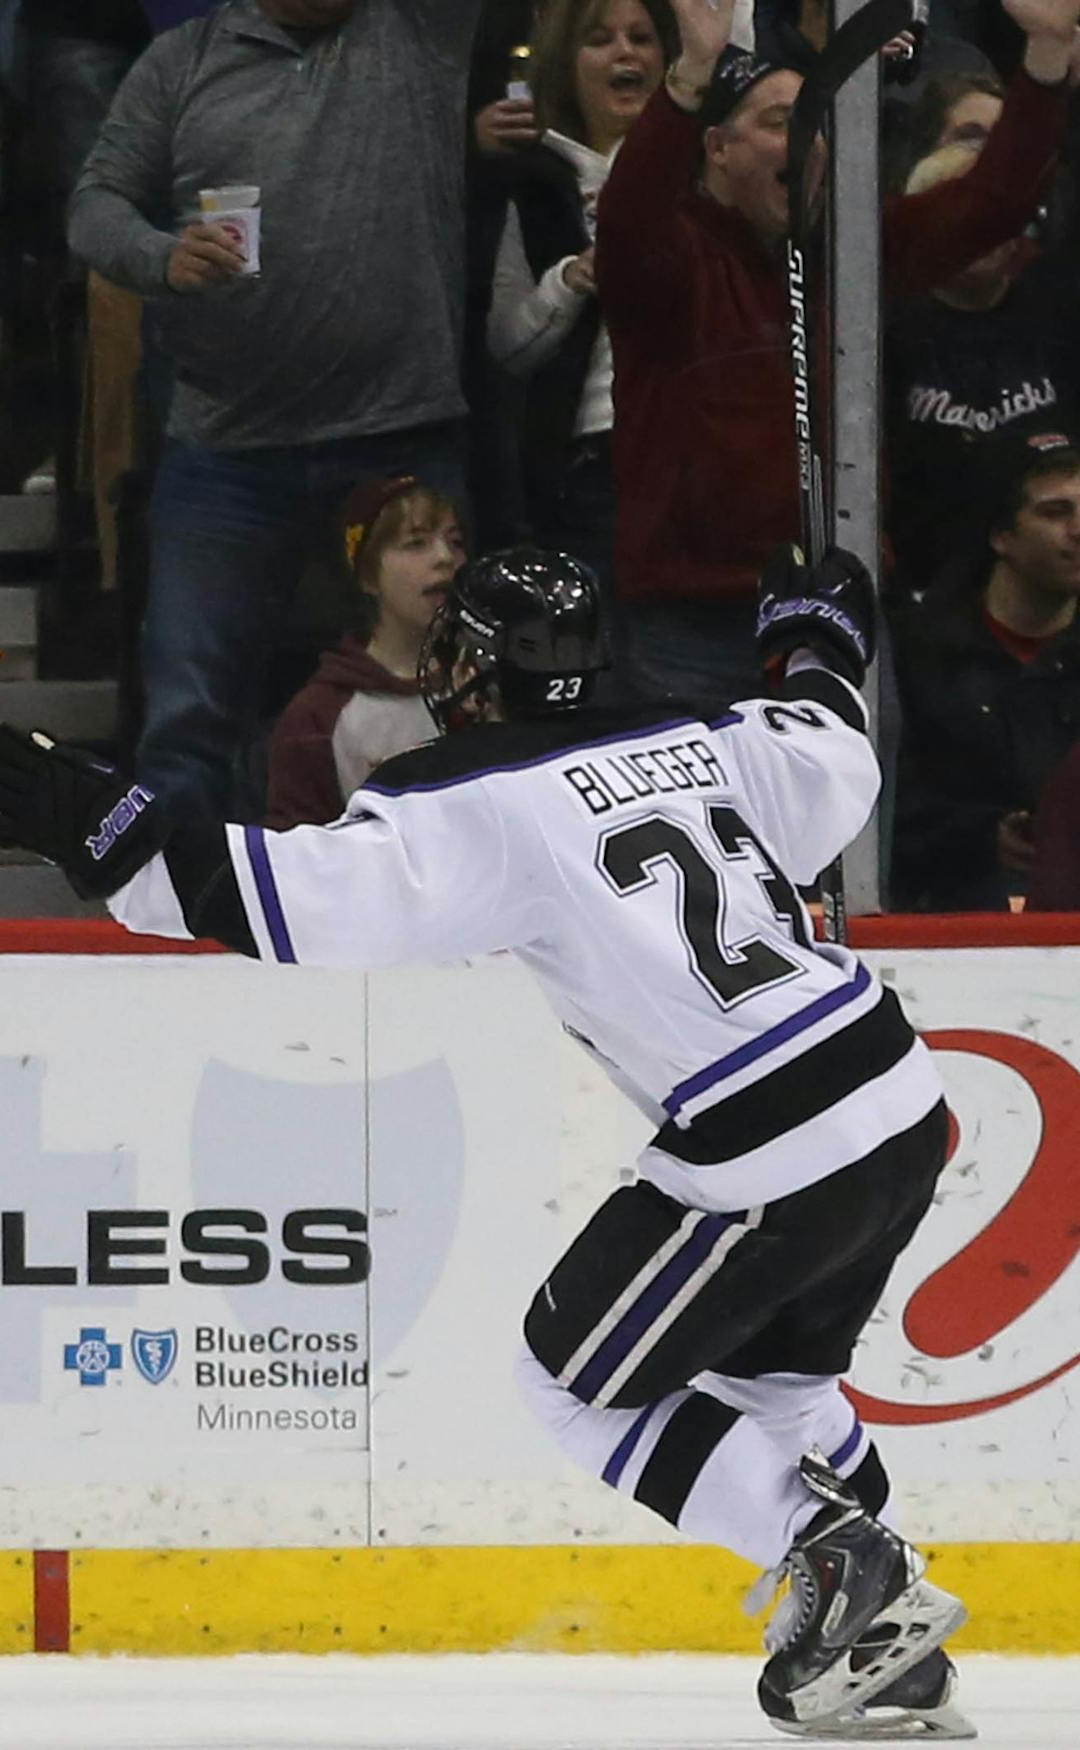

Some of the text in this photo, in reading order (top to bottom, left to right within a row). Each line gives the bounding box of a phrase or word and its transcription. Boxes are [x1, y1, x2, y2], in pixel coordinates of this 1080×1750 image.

[546, 677, 583, 701] 23
[563, 739, 729, 815] BLUEGER
[595, 800, 809, 1014] 23
[194, 1326, 359, 1353] BlueCross
[194, 1360, 369, 1388] BlueShield
[196, 1404, 358, 1431] Minnesota
